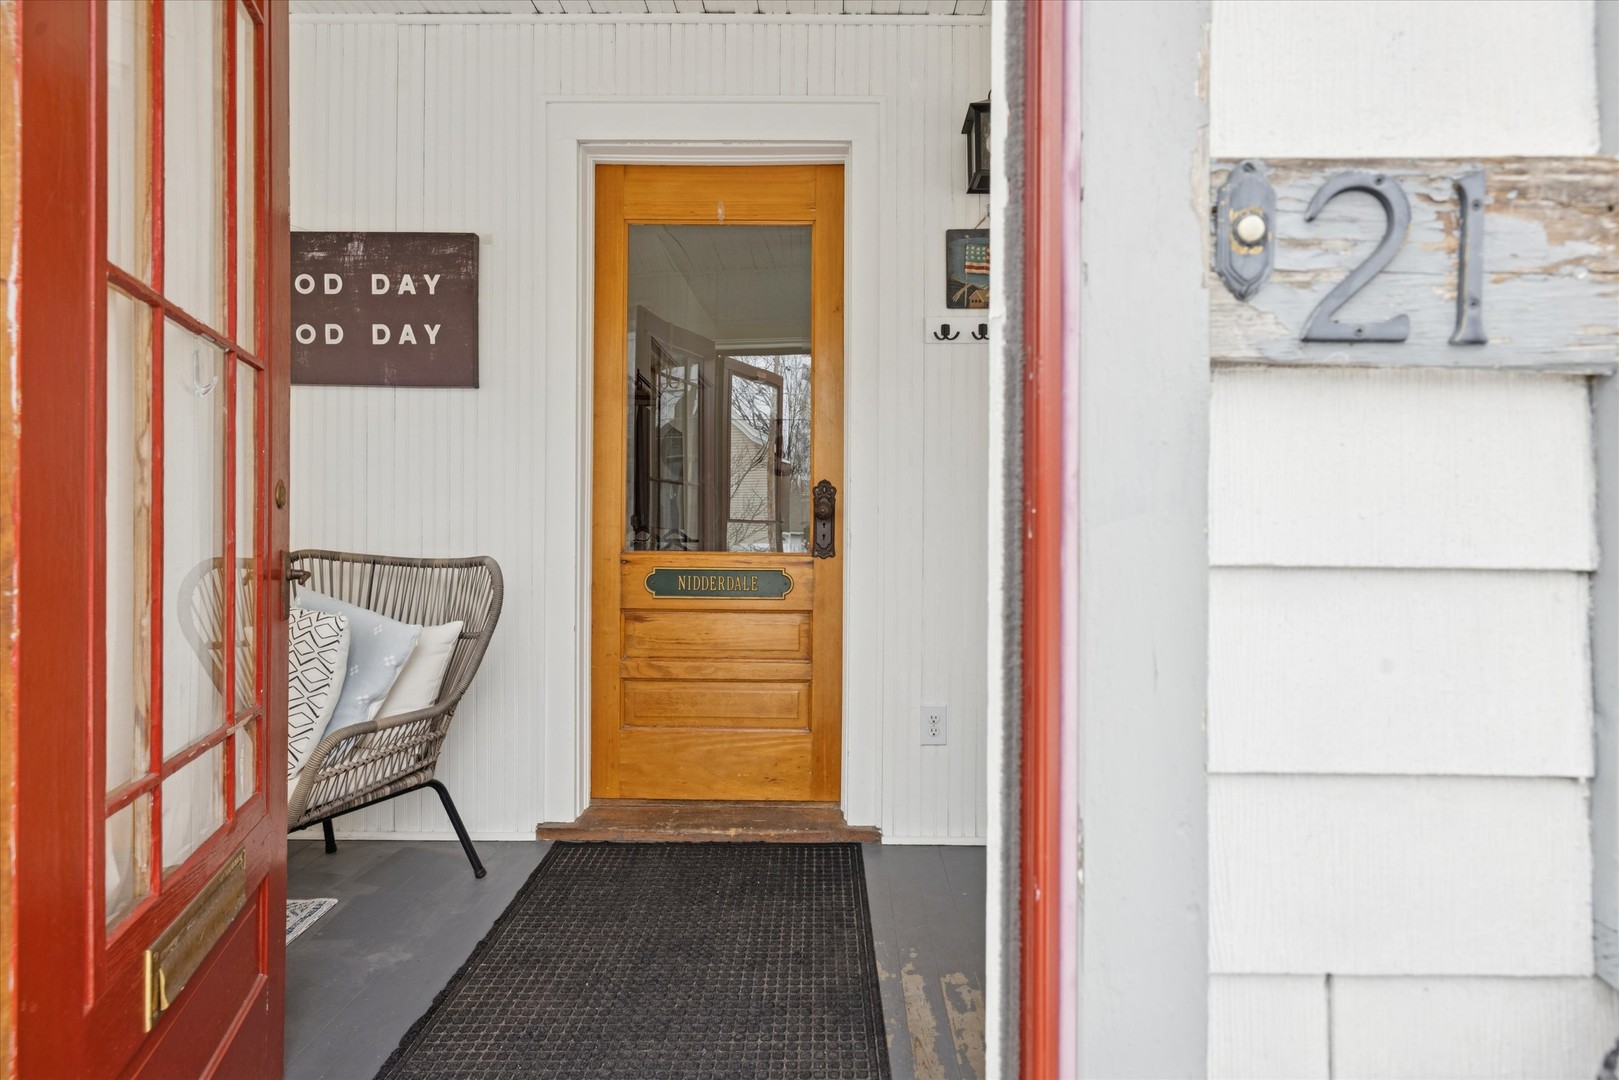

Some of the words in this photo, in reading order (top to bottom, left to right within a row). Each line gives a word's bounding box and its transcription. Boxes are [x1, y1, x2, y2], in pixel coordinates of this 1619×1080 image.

[1301, 167, 1488, 346] 21
[371, 273, 441, 295] DAY
[371, 323, 441, 345] DAY
[677, 575, 759, 591] NIDDERDALE
